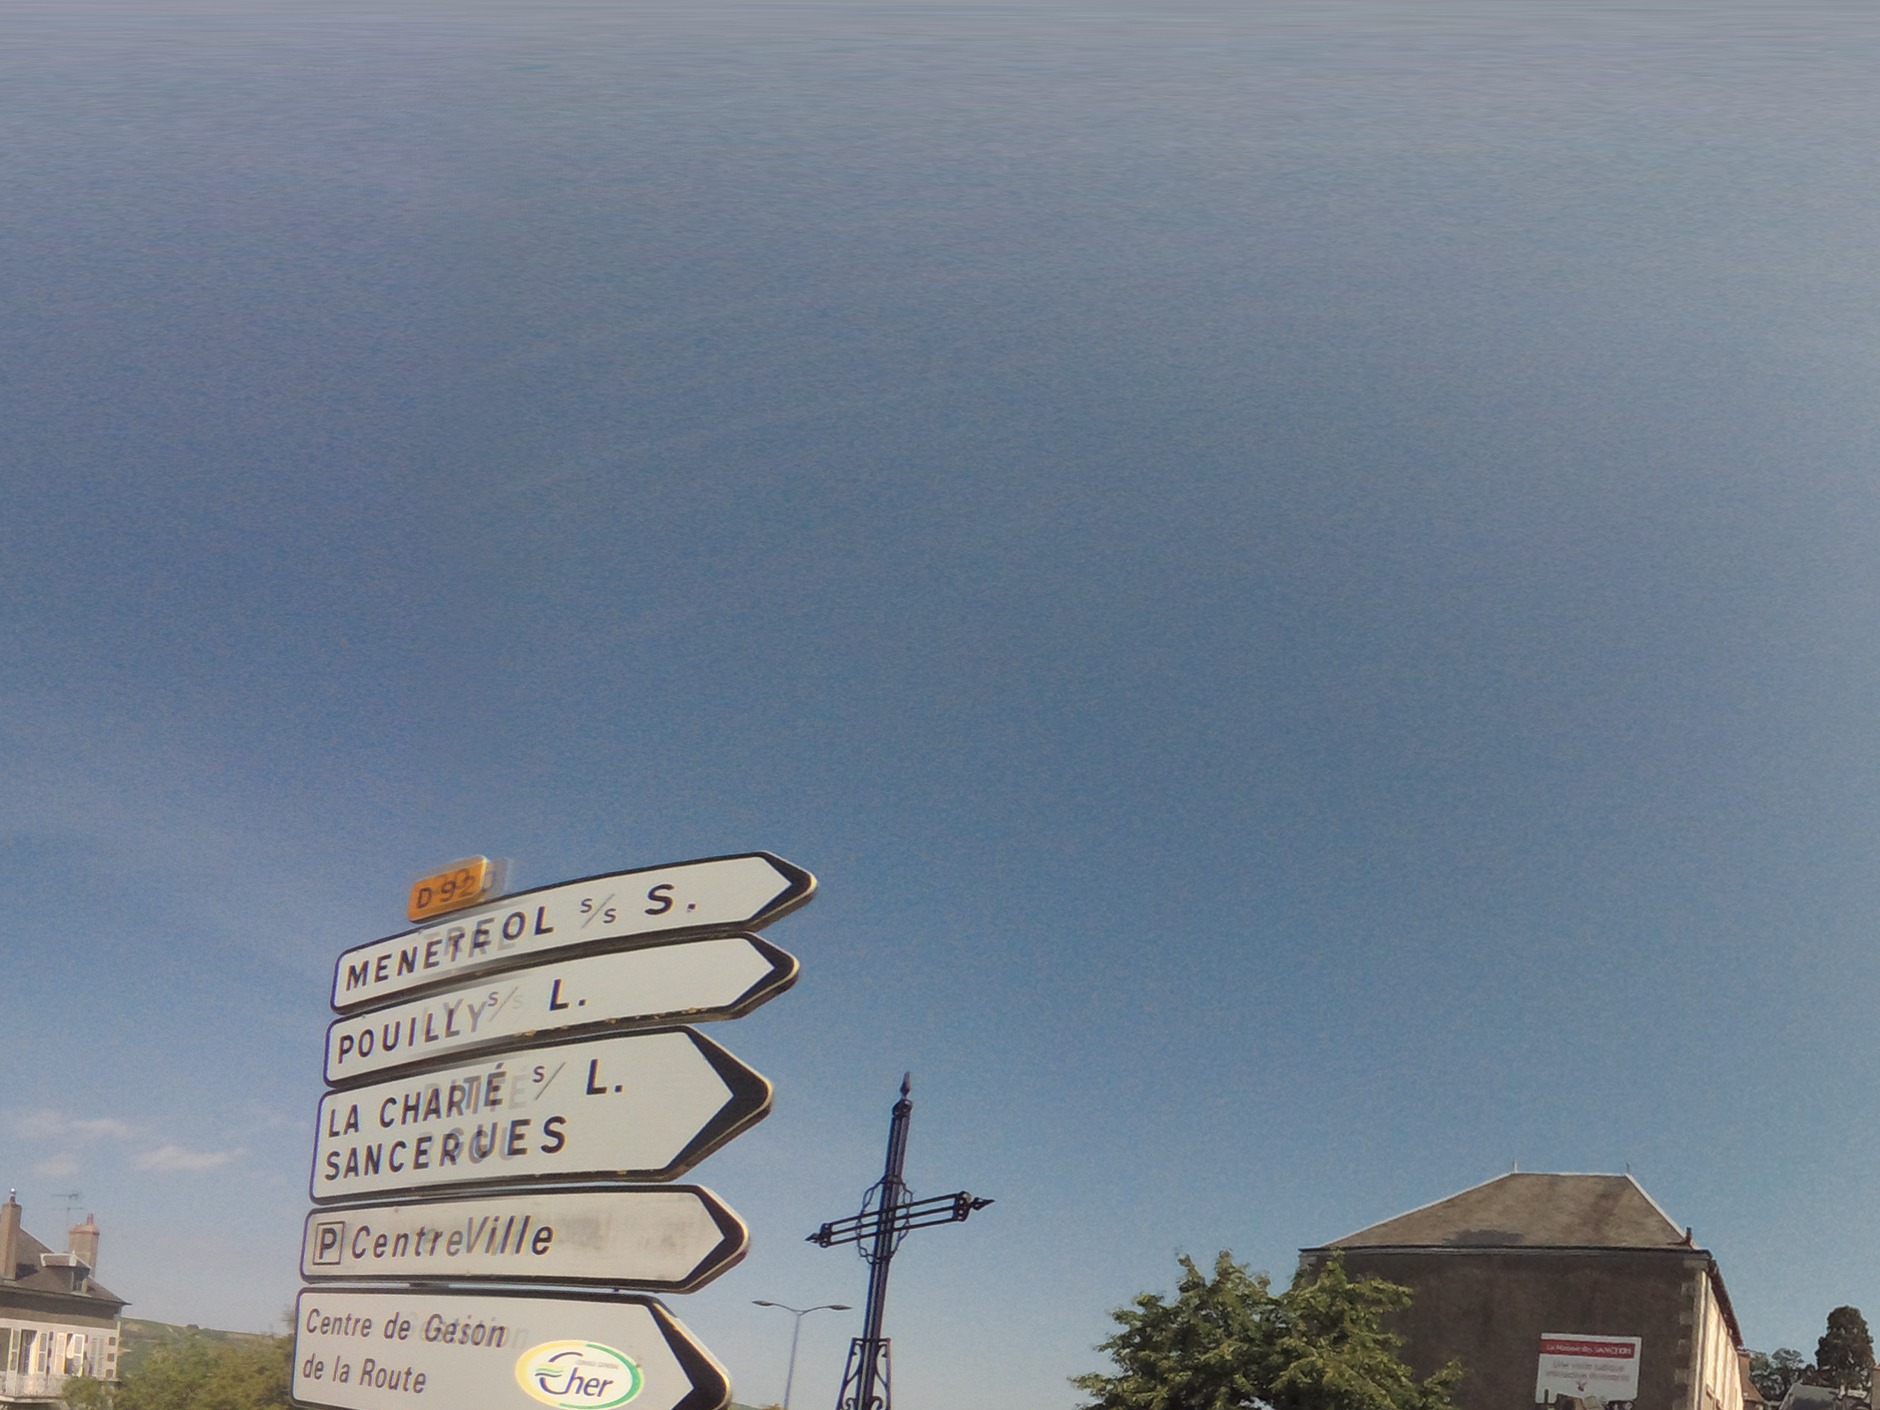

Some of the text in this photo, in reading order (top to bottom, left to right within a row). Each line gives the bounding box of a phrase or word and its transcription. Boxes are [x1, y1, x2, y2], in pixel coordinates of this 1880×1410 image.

[548, 978, 586, 1011] L.
[328, 1104, 359, 1138] LA
[585, 1058, 623, 1096] L.
[306, 1307, 373, 1338] Centre
[383, 1311, 412, 1341] de
[301, 1352, 427, 1394] de la Route
[537, 1351, 615, 1398] Cher
